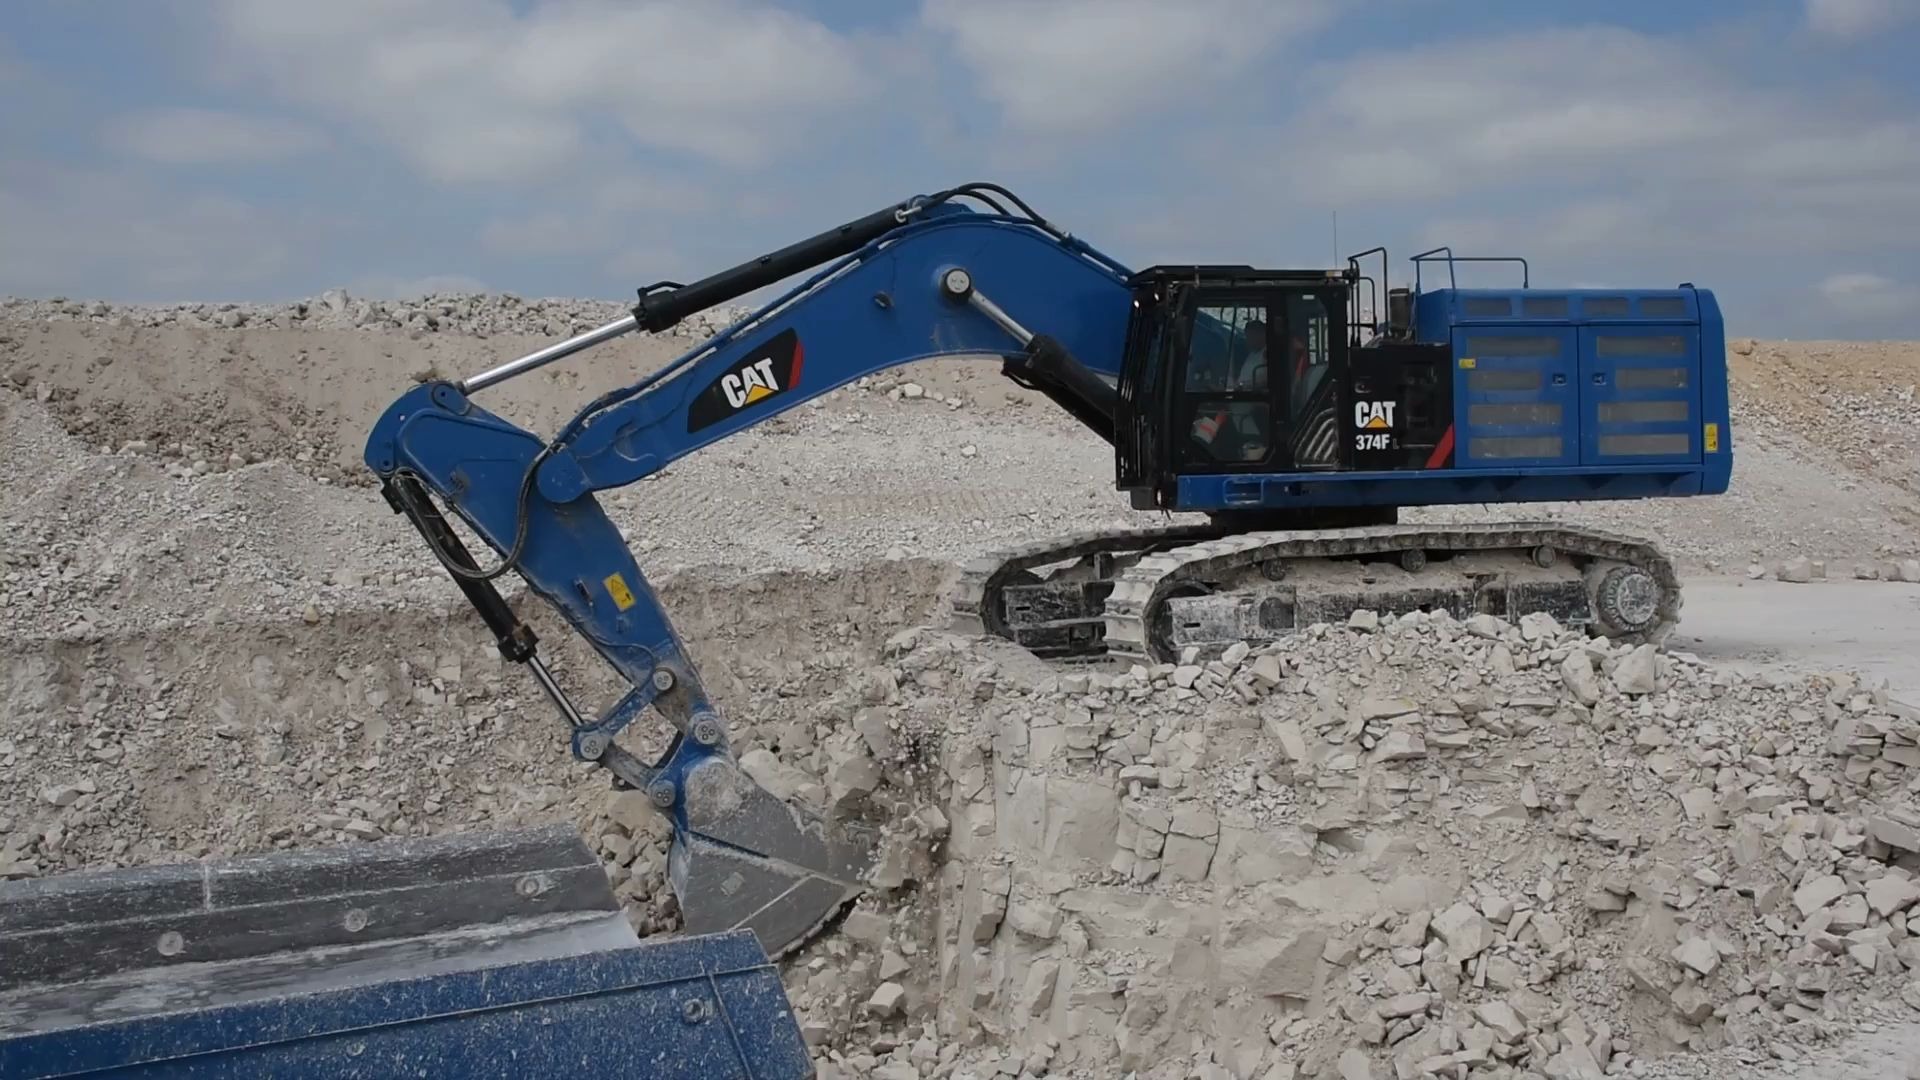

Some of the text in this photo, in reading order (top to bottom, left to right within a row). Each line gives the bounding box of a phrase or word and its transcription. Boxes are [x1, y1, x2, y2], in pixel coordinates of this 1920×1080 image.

[721, 357, 779, 408] CAT
[1355, 401, 1396, 428] CAT
[1355, 434, 1390, 450] 374F
